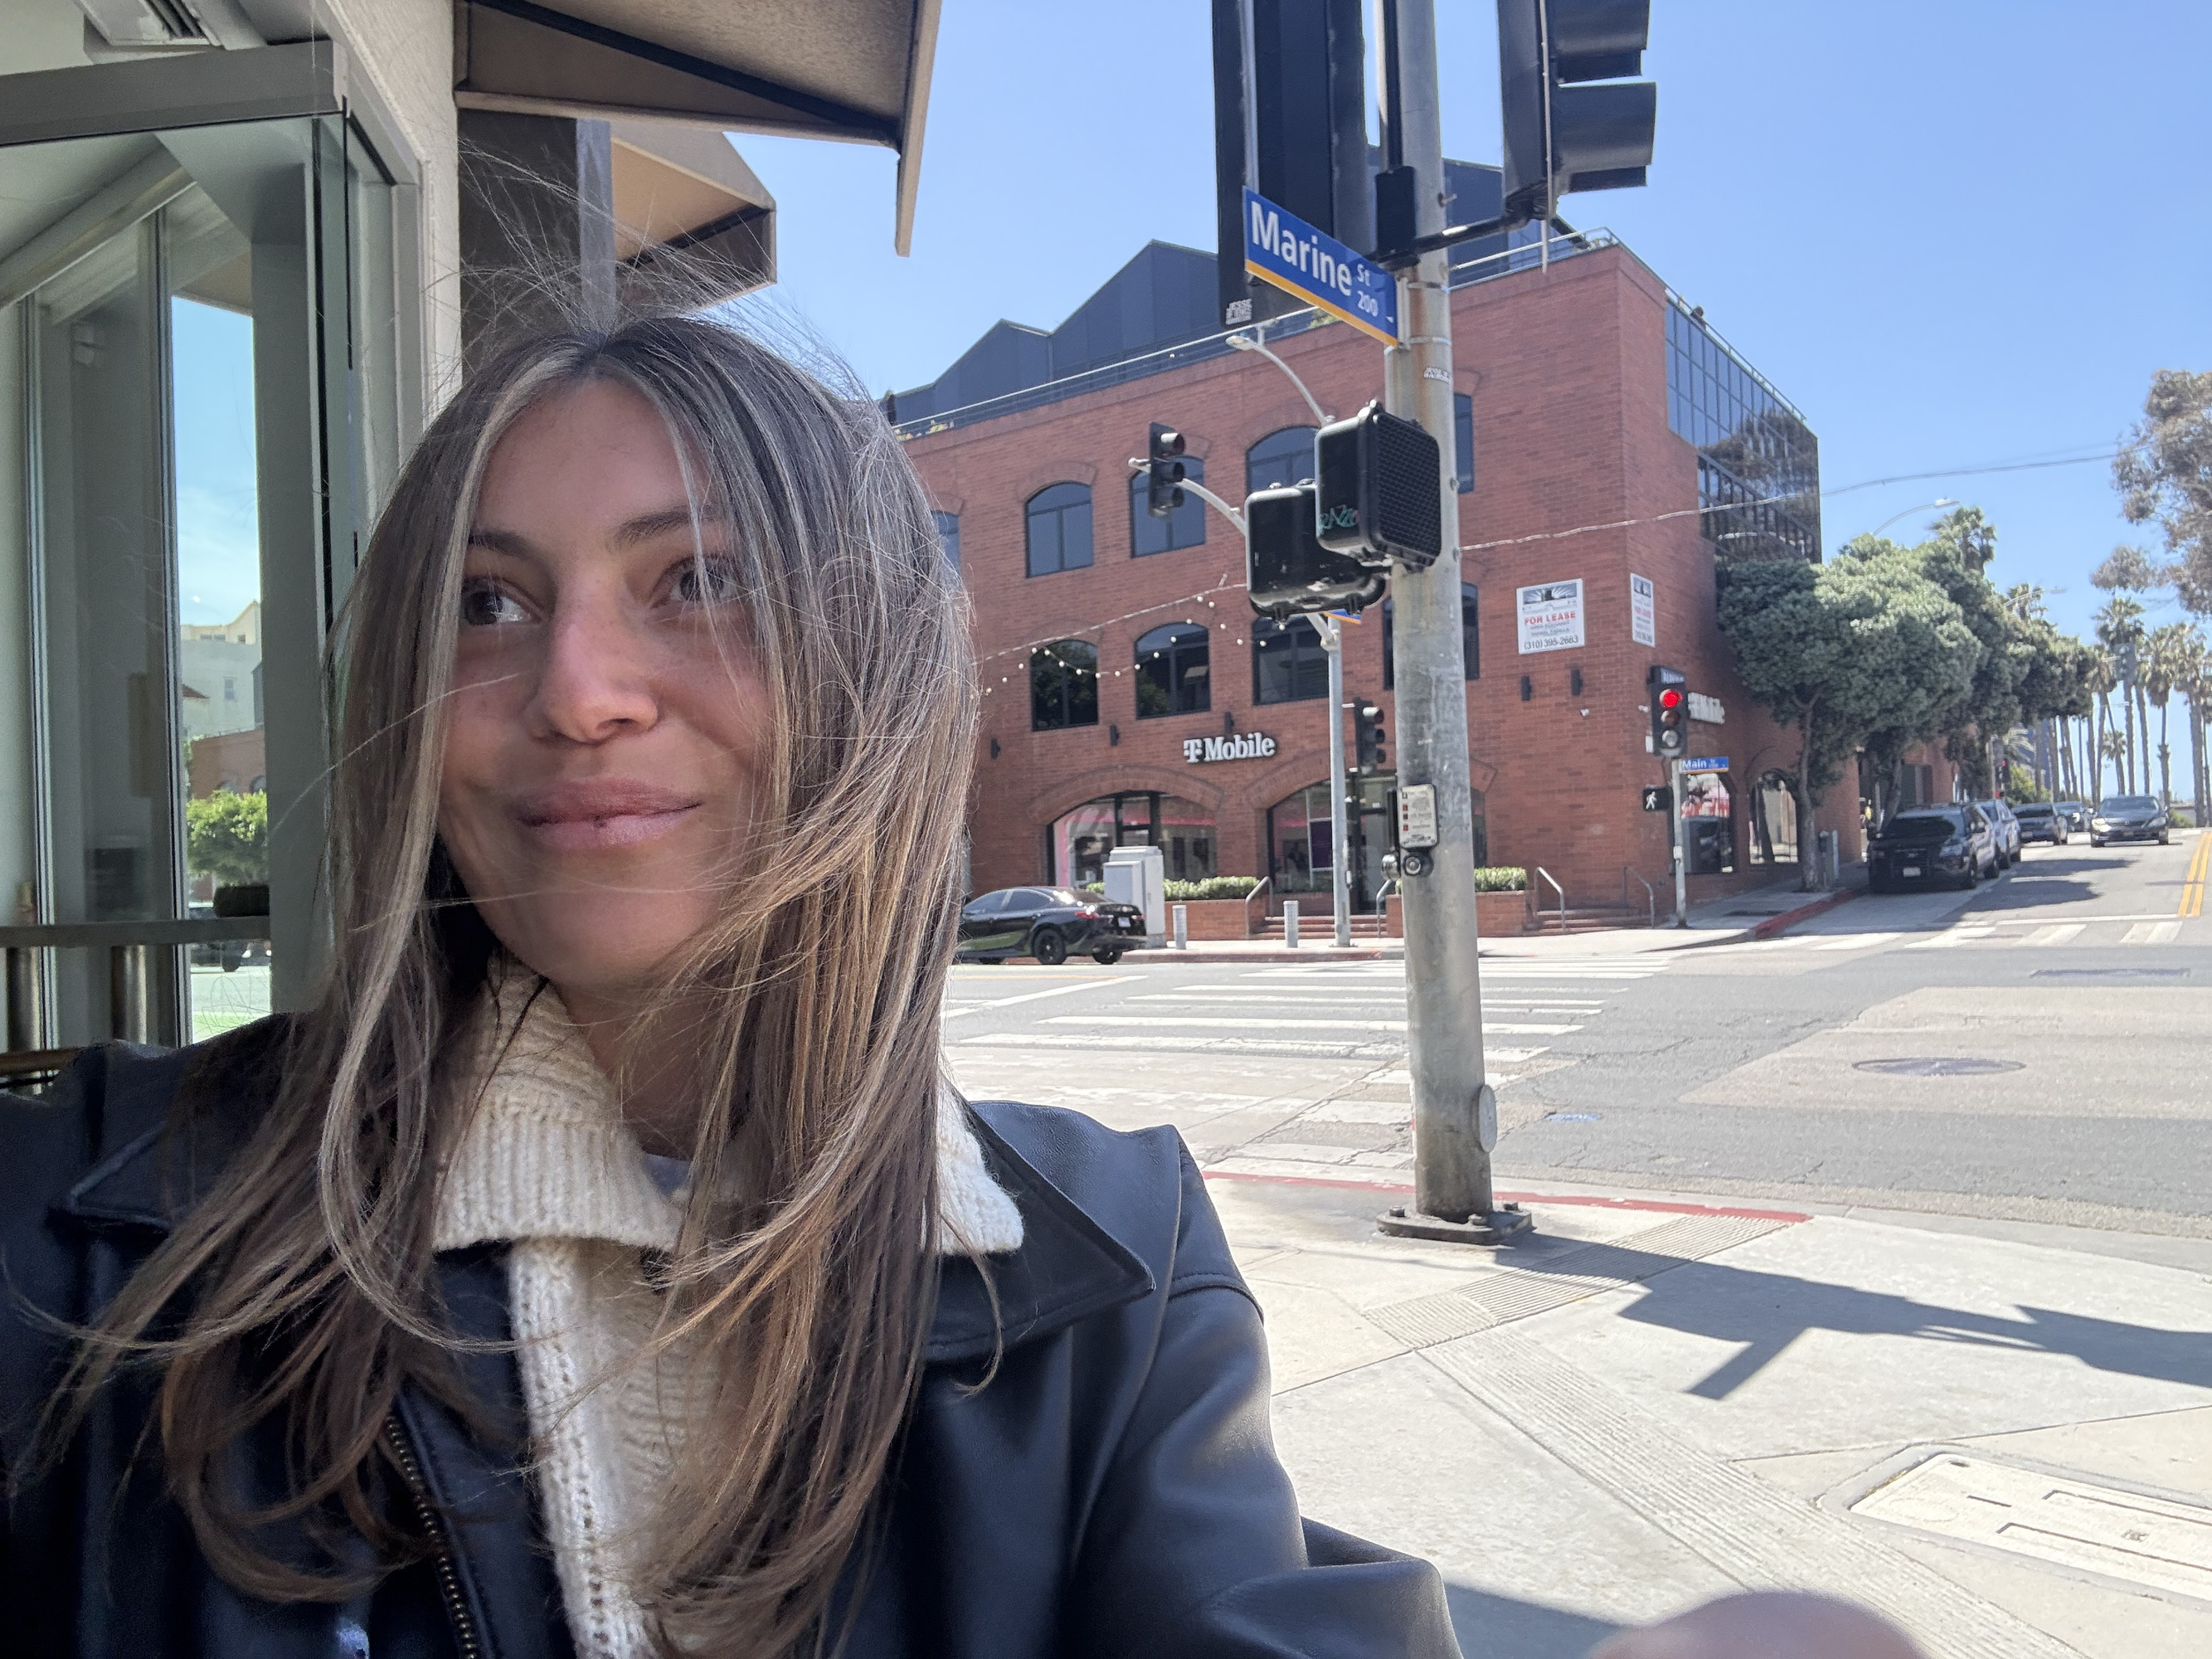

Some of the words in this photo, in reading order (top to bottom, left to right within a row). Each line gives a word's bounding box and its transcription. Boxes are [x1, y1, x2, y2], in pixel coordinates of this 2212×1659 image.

[1251, 201, 1352, 296] Marine
[1357, 263, 1371, 287] St
[1357, 290, 1378, 317] 200
[1546, 611, 1576, 622] LEASE
[1524, 639, 1543, 650] (310)
[1682, 758, 1707, 769] Main
